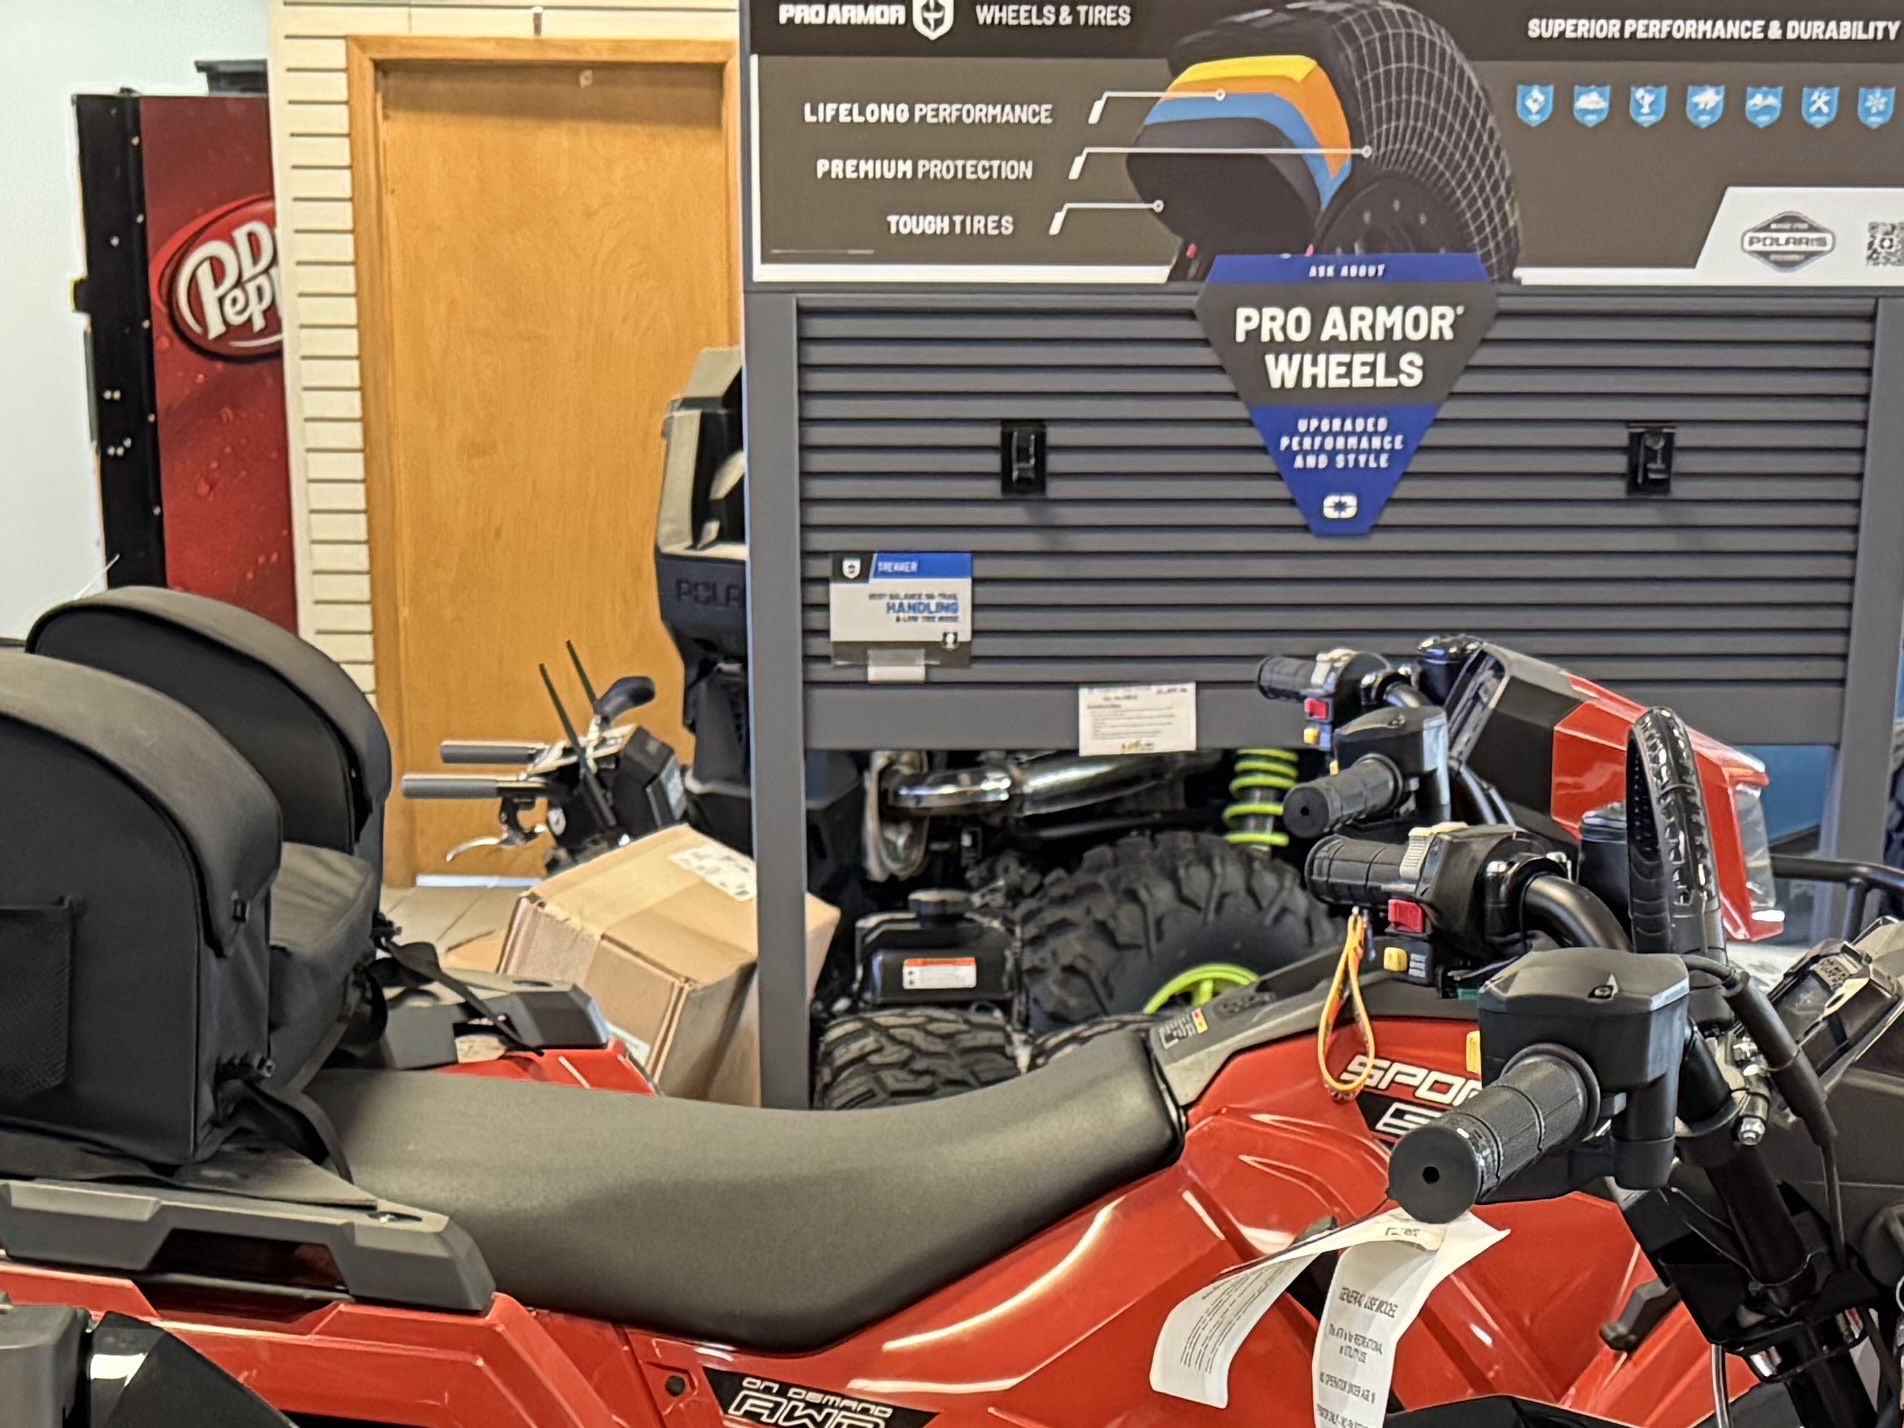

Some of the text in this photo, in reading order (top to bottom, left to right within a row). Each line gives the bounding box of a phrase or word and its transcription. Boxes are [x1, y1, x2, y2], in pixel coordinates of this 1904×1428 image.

[976, 5, 1131, 26] WHEELS & TIRES
[1527, 18, 1901, 41] SUPERIOR PERFORMANCE & DURABILITY
[804, 102, 1053, 124] LIFELONG PERFORMANCE
[816, 159, 1033, 180] PREMIUM PROTECTION
[886, 215, 1014, 235] TOUGH TIRES
[1749, 235, 1828, 248] POLARIS
[1309, 264, 1385, 278] ASK ABOUT
[1235, 306, 1312, 343] PRO
[1264, 352, 1424, 389] WHEELS
[1297, 416, 1389, 433] UPGRADED
[1280, 434, 1404, 452] PERFORMANCE
[1293, 453, 1389, 469] AND STYLE
[787, 1387, 893, 1419] DEMAND
